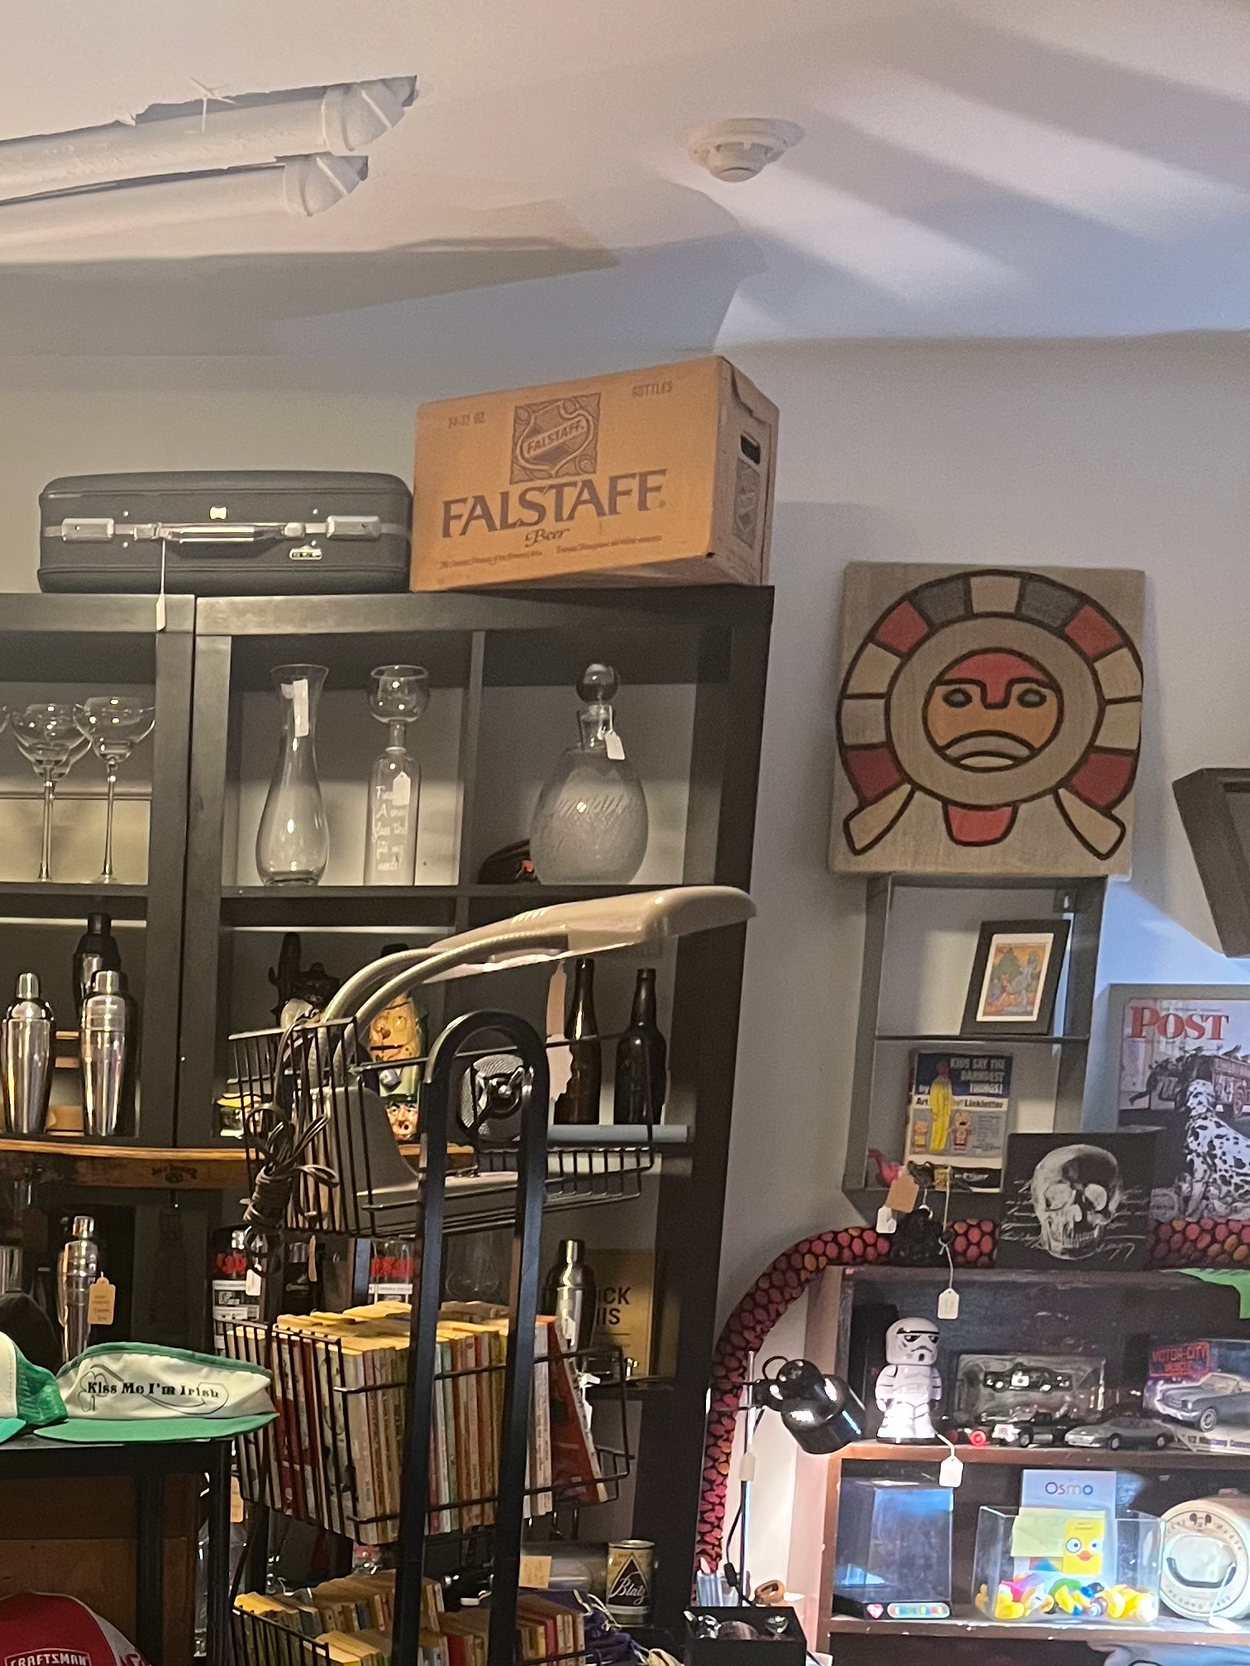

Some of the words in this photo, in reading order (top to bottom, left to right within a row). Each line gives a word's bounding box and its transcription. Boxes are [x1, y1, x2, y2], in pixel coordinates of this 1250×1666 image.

[526, 420, 586, 454] FALSTAFF
[442, 468, 668, 538] FALSTAFF
[525, 528, 570, 548] Beer
[1128, 1006, 1230, 1041] POST
[916, 1097, 928, 1106] Art
[964, 1099, 1004, 1109] Linkletter
[87, 1381, 117, 1395] Kiss
[121, 1382, 145, 1395] Me
[147, 1383, 176, 1396] I'm
[180, 1384, 220, 1399] Irish
[1045, 1481, 1094, 1496] Osmo
[611, 1571, 646, 1605] Blatz
